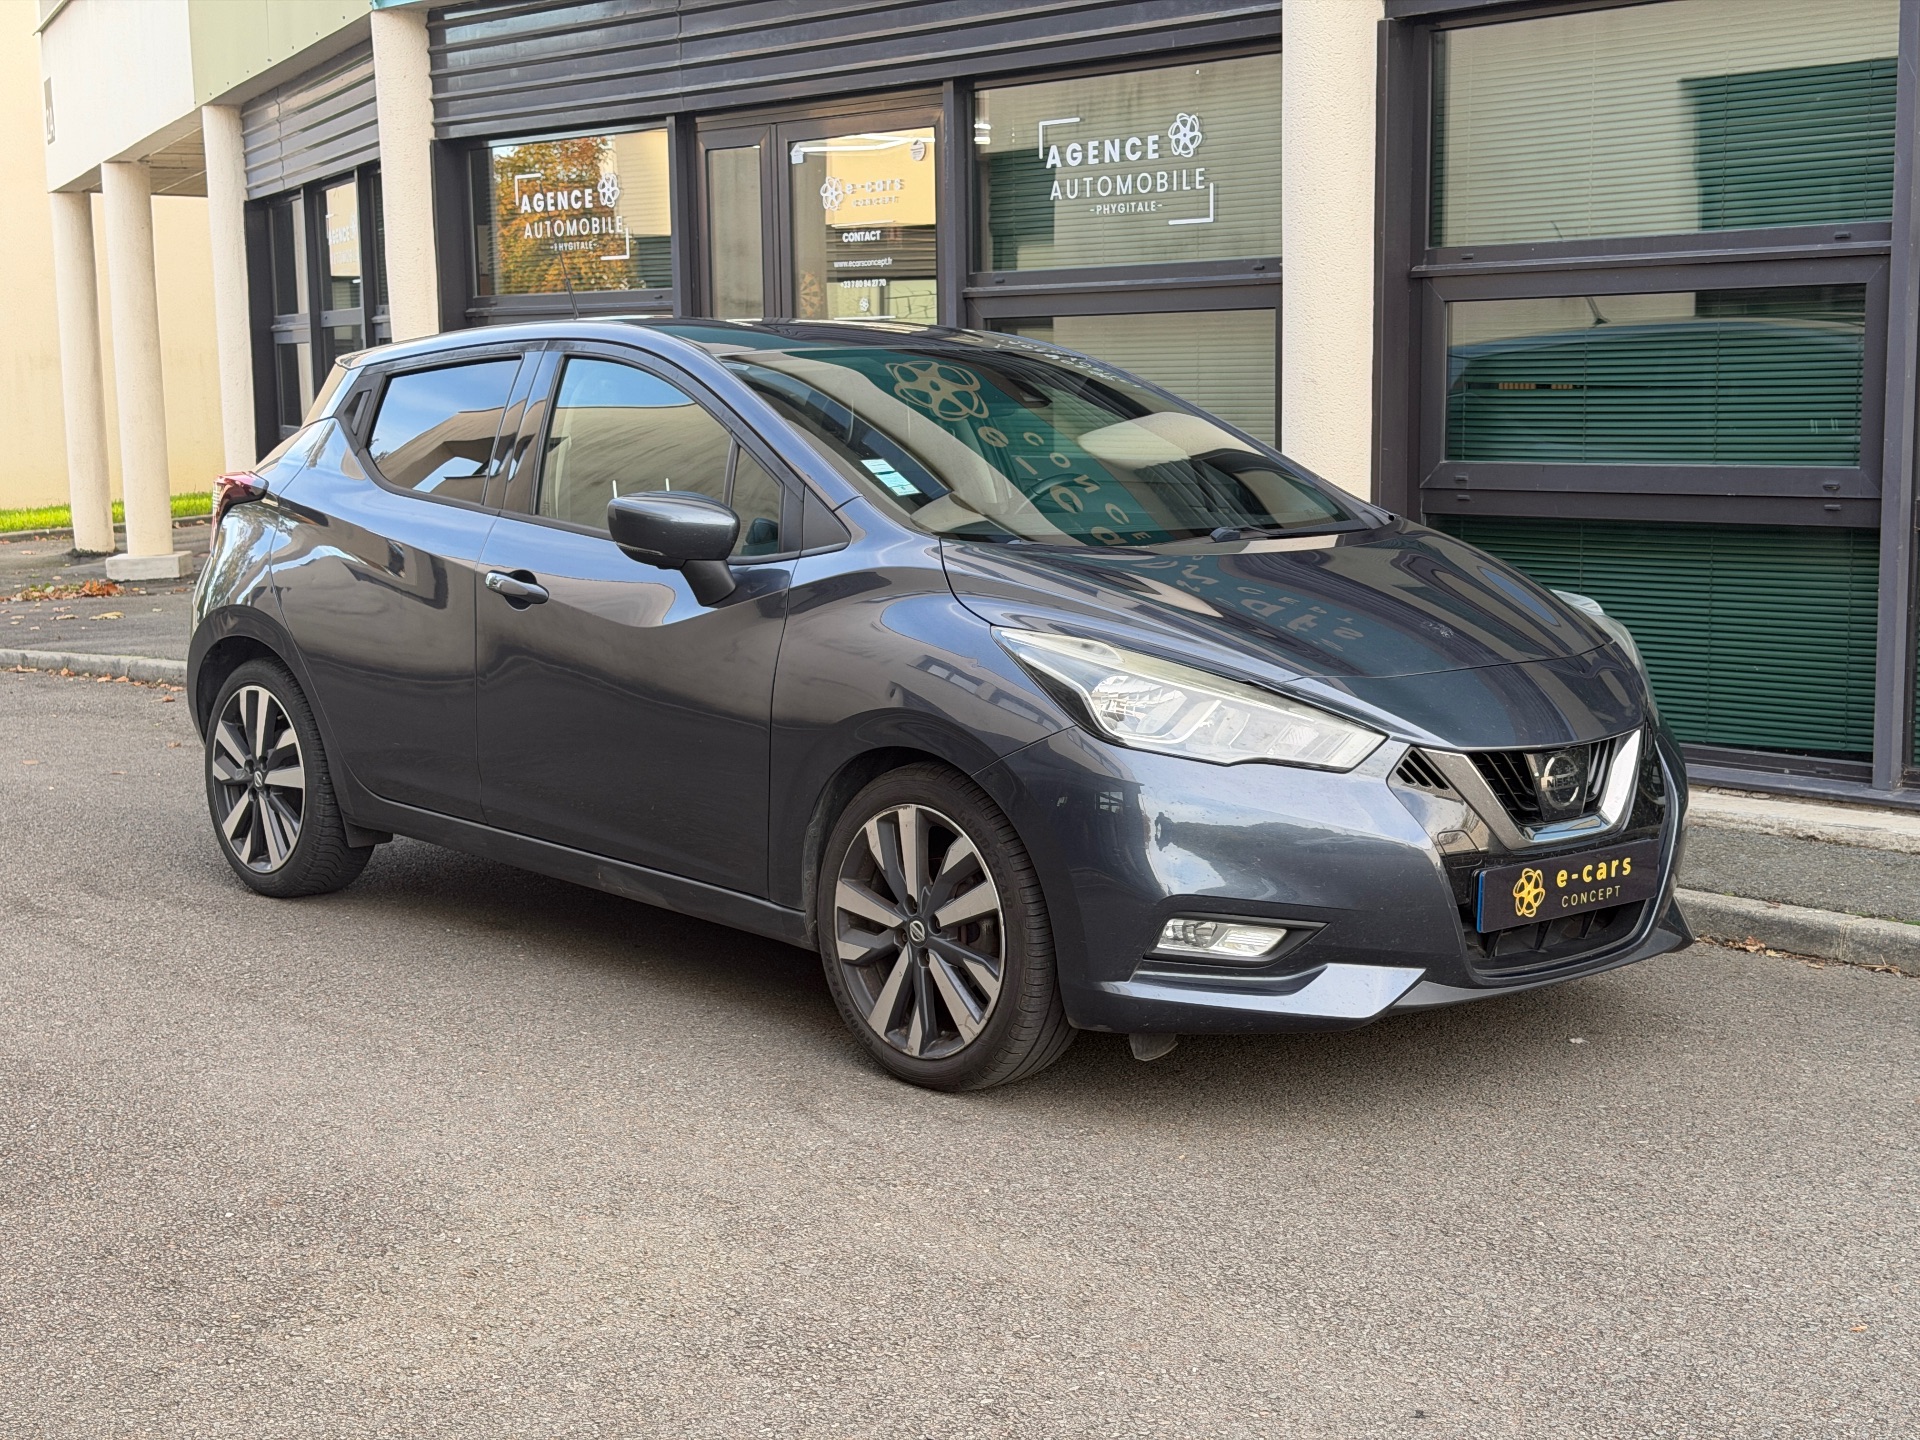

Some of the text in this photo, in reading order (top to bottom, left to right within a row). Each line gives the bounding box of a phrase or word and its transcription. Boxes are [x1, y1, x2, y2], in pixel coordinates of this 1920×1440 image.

[1046, 135, 1160, 169] AGENCE
[1050, 167, 1206, 201] AUTOMOBILE
[521, 188, 594, 213] AGENCE
[524, 215, 623, 240] AUTOMOBILE
[842, 230, 881, 242] CONTACT
[1556, 856, 1632, 888] e-cars
[1561, 885, 1621, 908] CONCEPT
